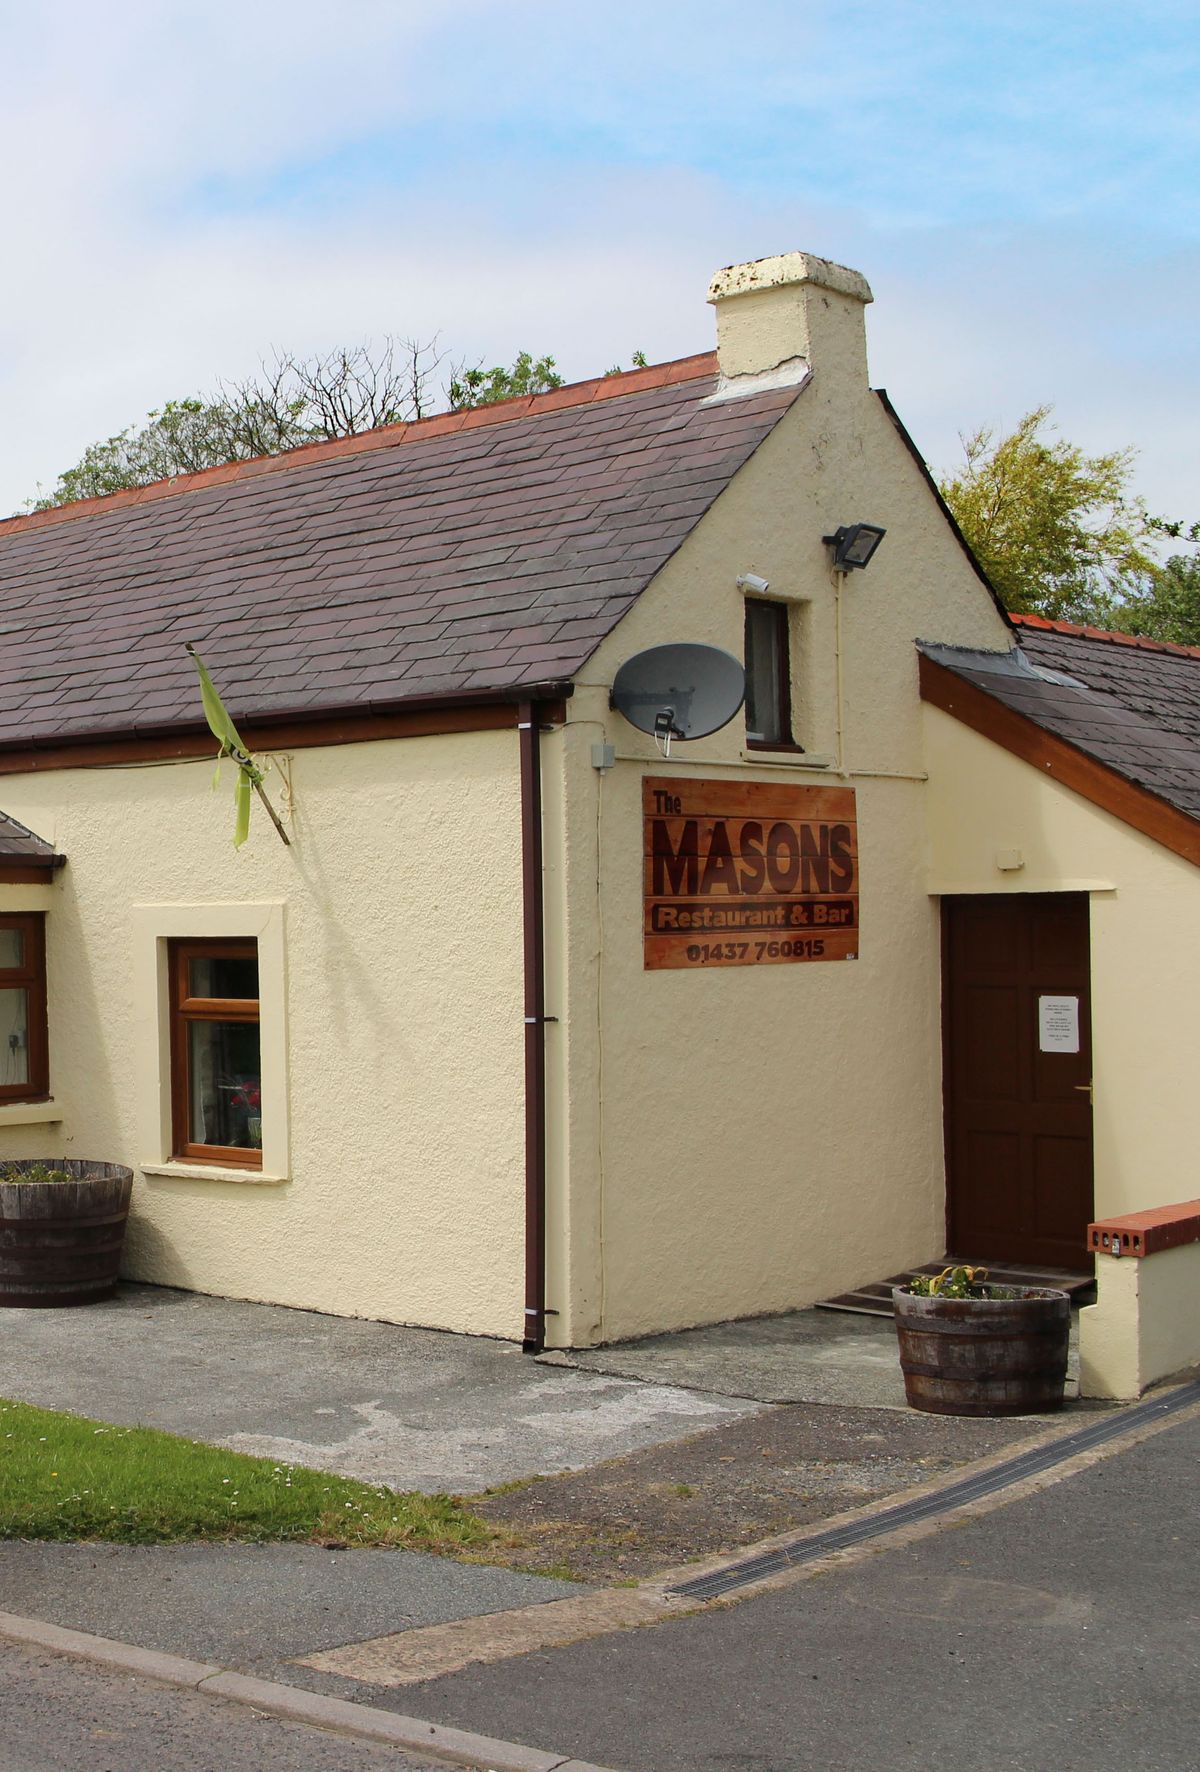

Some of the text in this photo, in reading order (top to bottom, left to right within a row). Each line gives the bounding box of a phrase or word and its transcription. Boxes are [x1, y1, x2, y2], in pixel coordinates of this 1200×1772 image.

[653, 790, 681, 814] The
[652, 820, 853, 895] MASONS
[657, 904, 849, 929] Restaurant & Bar
[686, 939, 825, 962] 01437 760815
